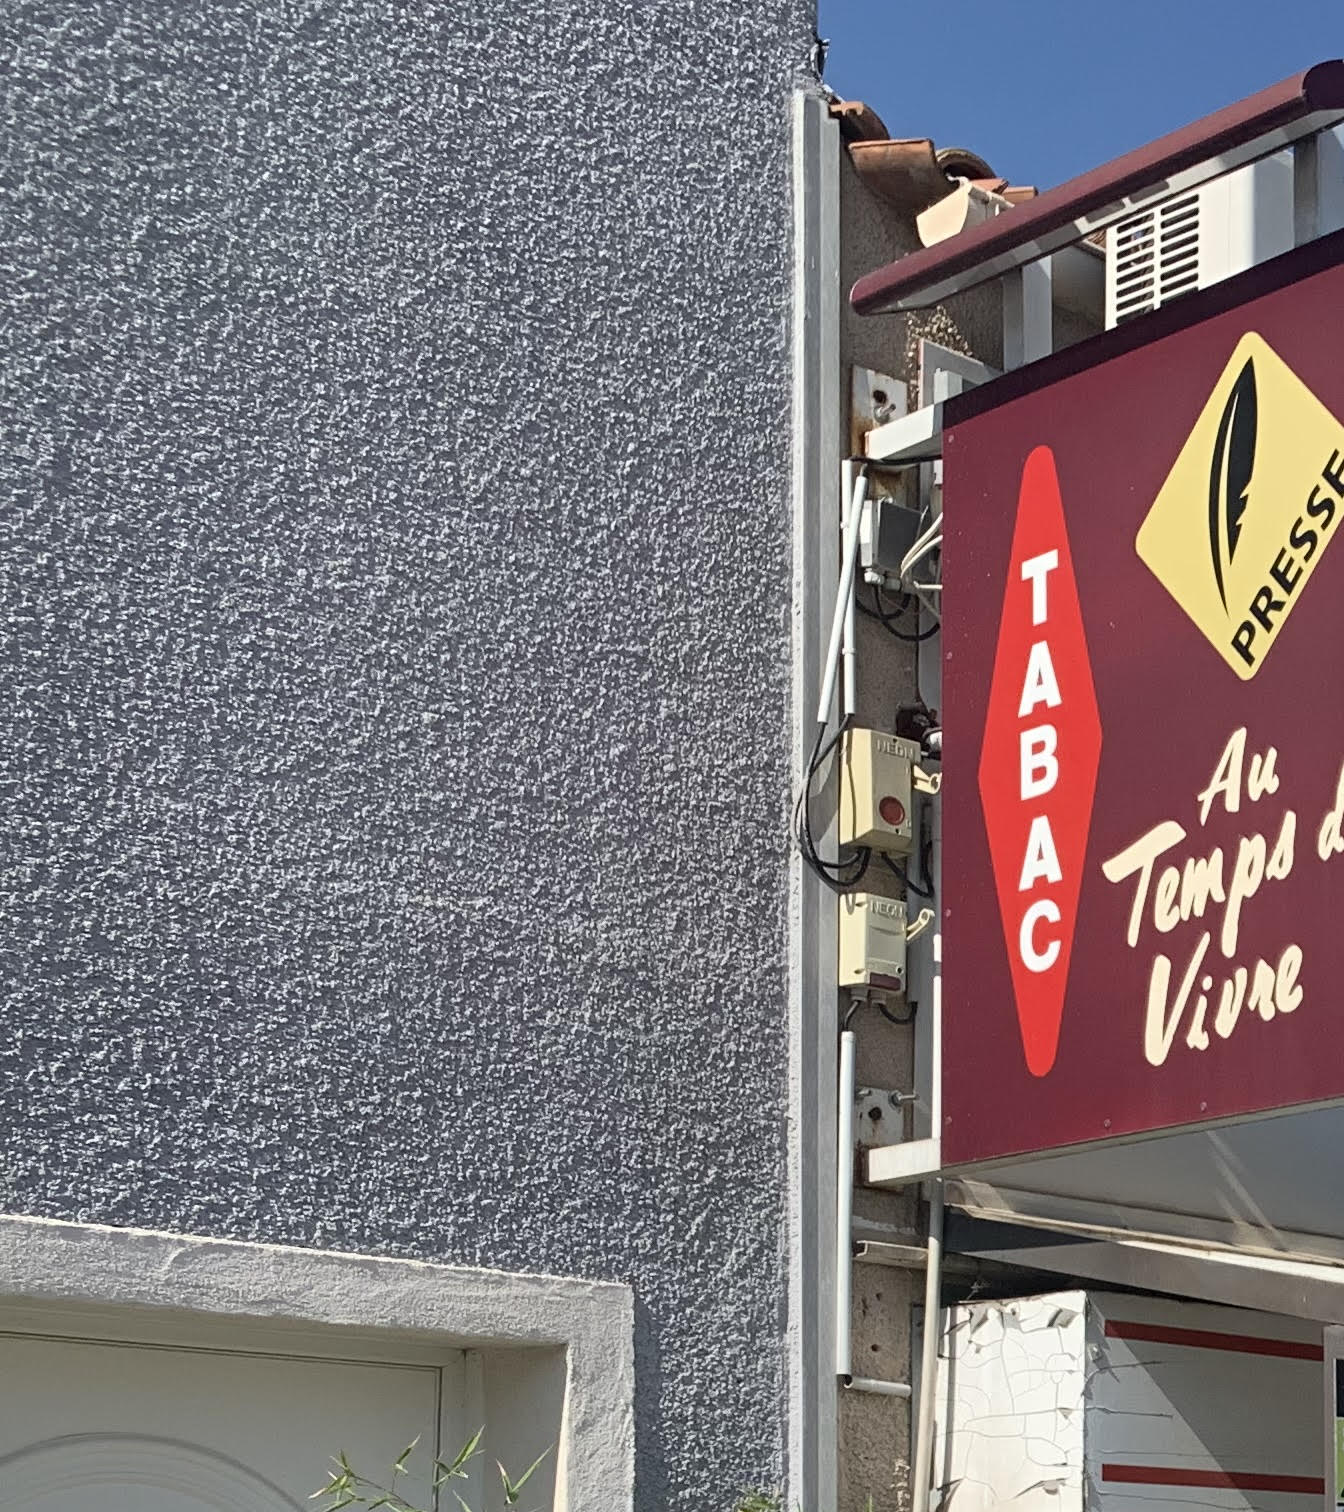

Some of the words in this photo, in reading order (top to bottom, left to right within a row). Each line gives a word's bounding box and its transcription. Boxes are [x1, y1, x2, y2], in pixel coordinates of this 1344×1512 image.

[1019, 550, 1062, 973] TABAC
[1198, 727, 1279, 825] Au
[1102, 808, 1294, 955] Temps
[1145, 934, 1305, 1068] Vivre
